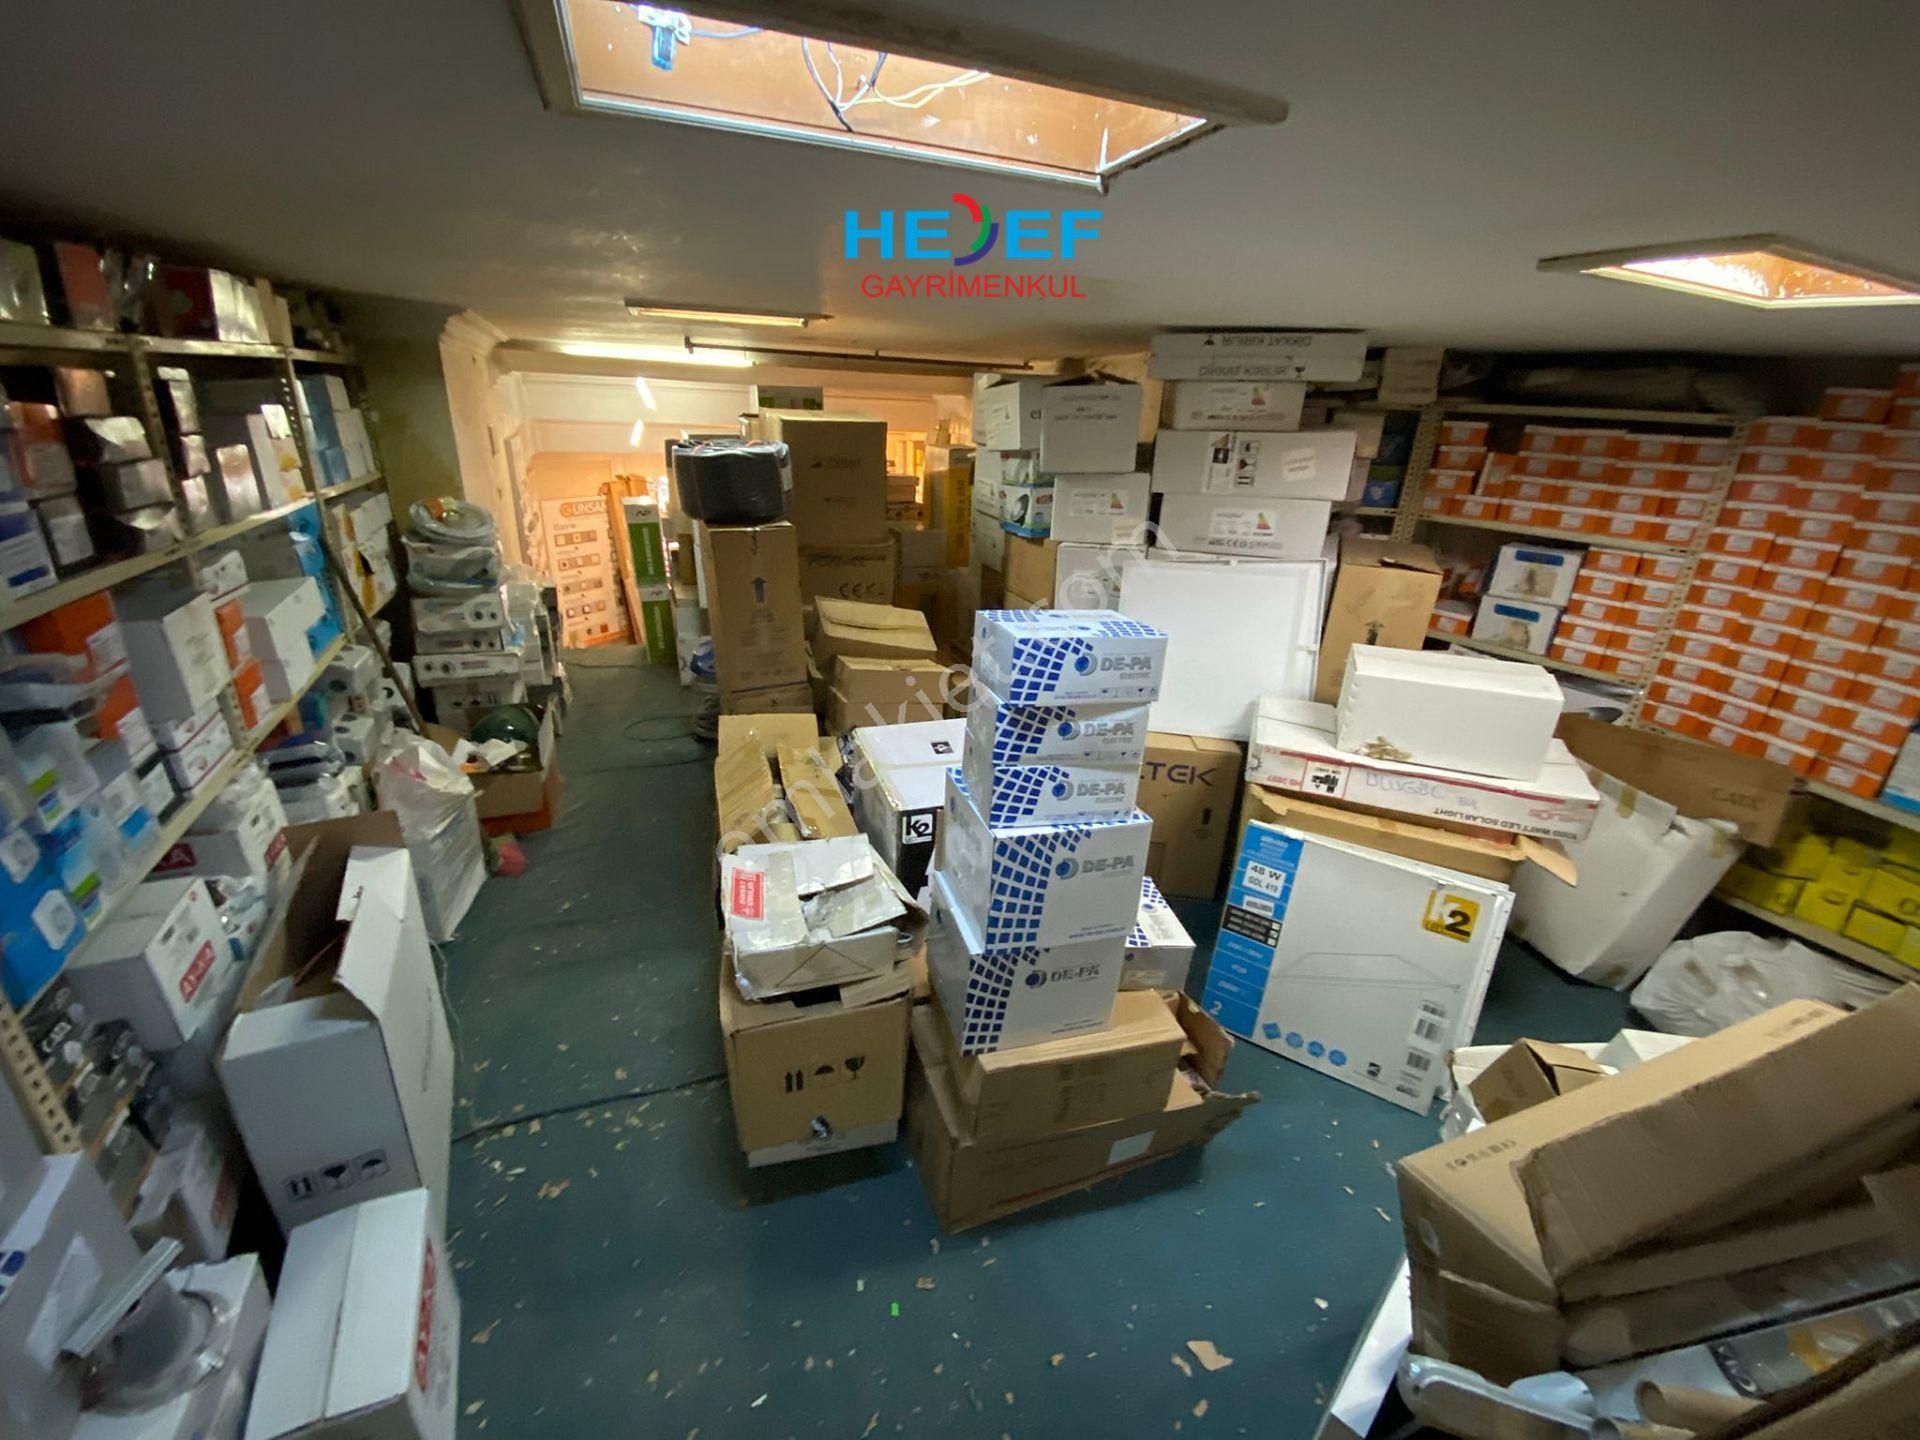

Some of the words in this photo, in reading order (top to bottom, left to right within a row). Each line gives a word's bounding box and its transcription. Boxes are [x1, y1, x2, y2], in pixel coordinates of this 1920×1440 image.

[1100, 656, 1152, 671] DE-PA
[1083, 721, 1135, 737] DE-PA
[1140, 761, 1216, 786] TEK
[1076, 782, 1127, 797] DE-PA
[1433, 807, 1464, 820] LIGHT
[1464, 813, 1499, 826] SOLAR
[1500, 819, 1521, 831] LED
[1523, 824, 1551, 836] WATT
[1081, 855, 1135, 874] DE-PA
[1050, 965, 1100, 983] DE-PA
